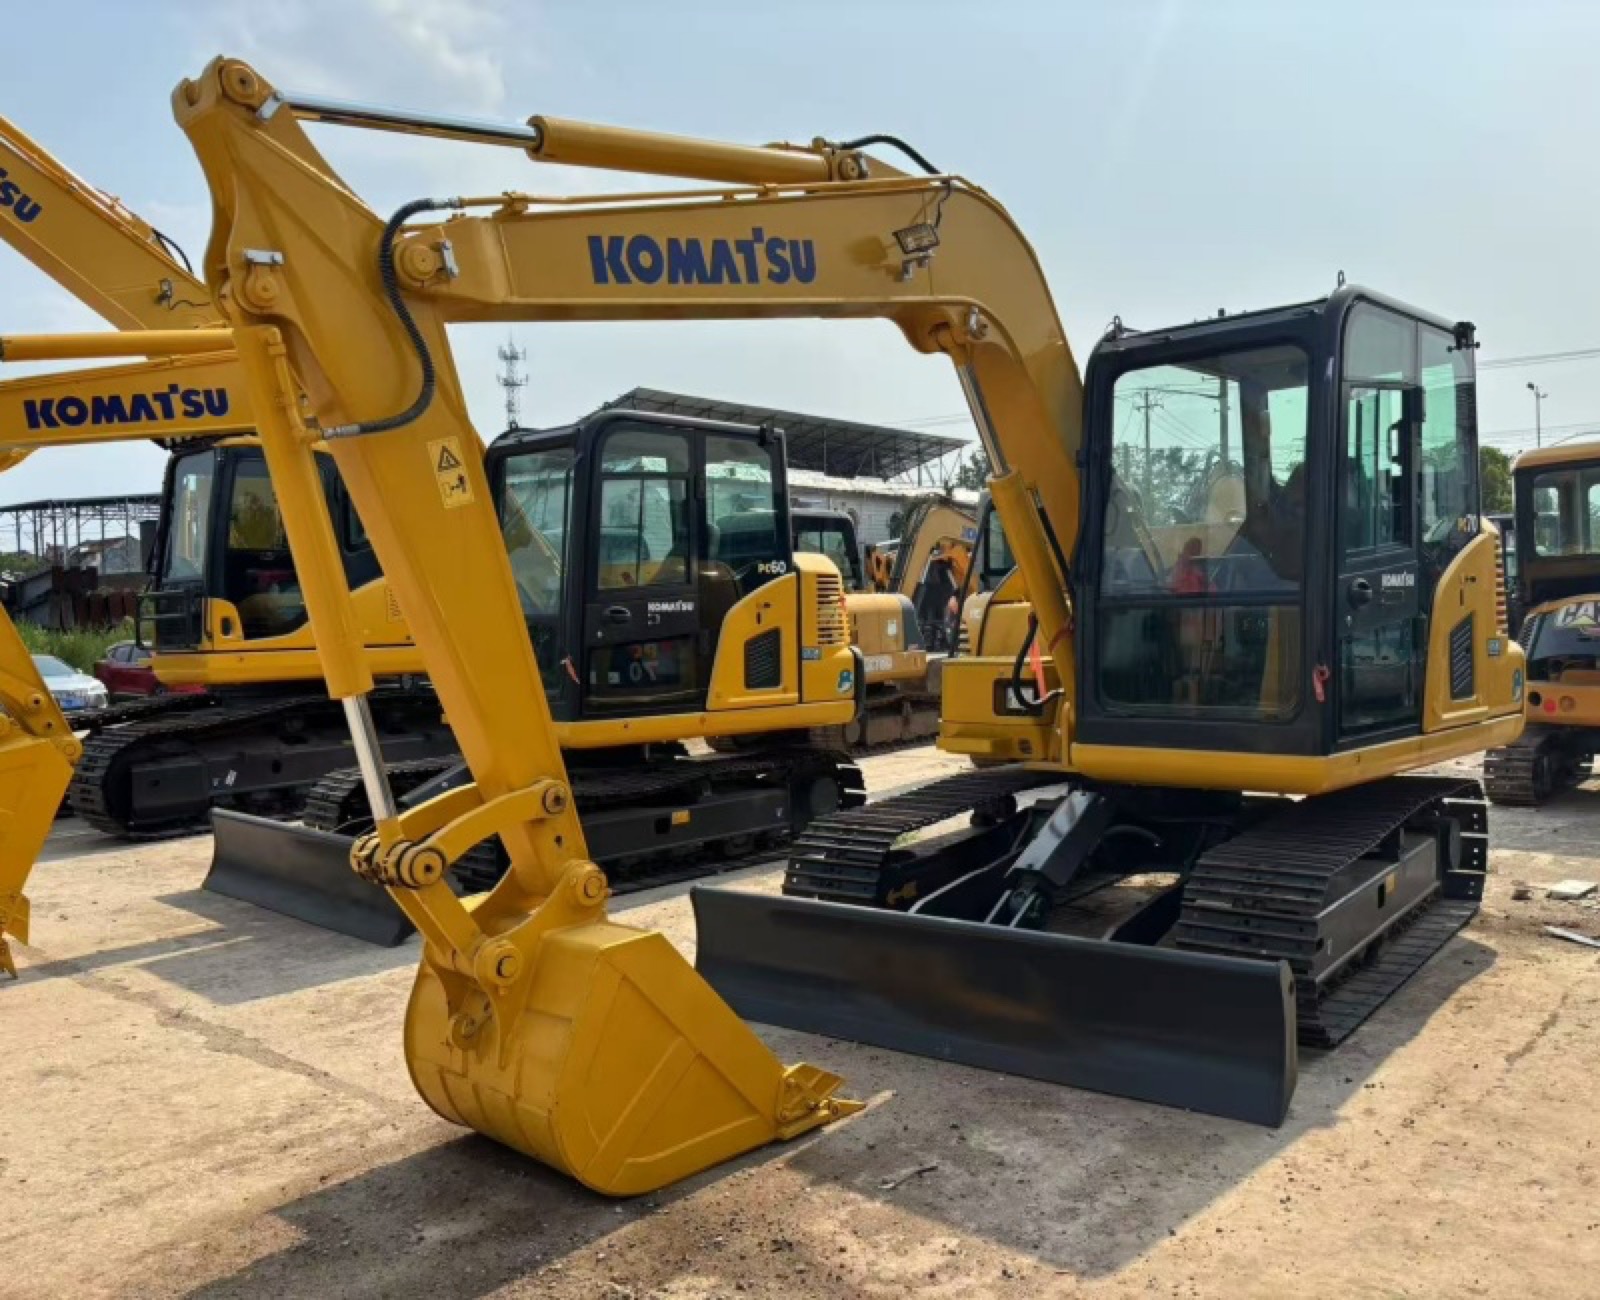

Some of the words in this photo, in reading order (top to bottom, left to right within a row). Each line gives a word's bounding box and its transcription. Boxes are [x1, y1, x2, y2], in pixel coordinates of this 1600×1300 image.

[588, 227, 816, 284] KOMATSU
[24, 384, 228, 429] KOMATSU
[647, 600, 695, 611] KOMATSU
[1556, 602, 1600, 627] CA
